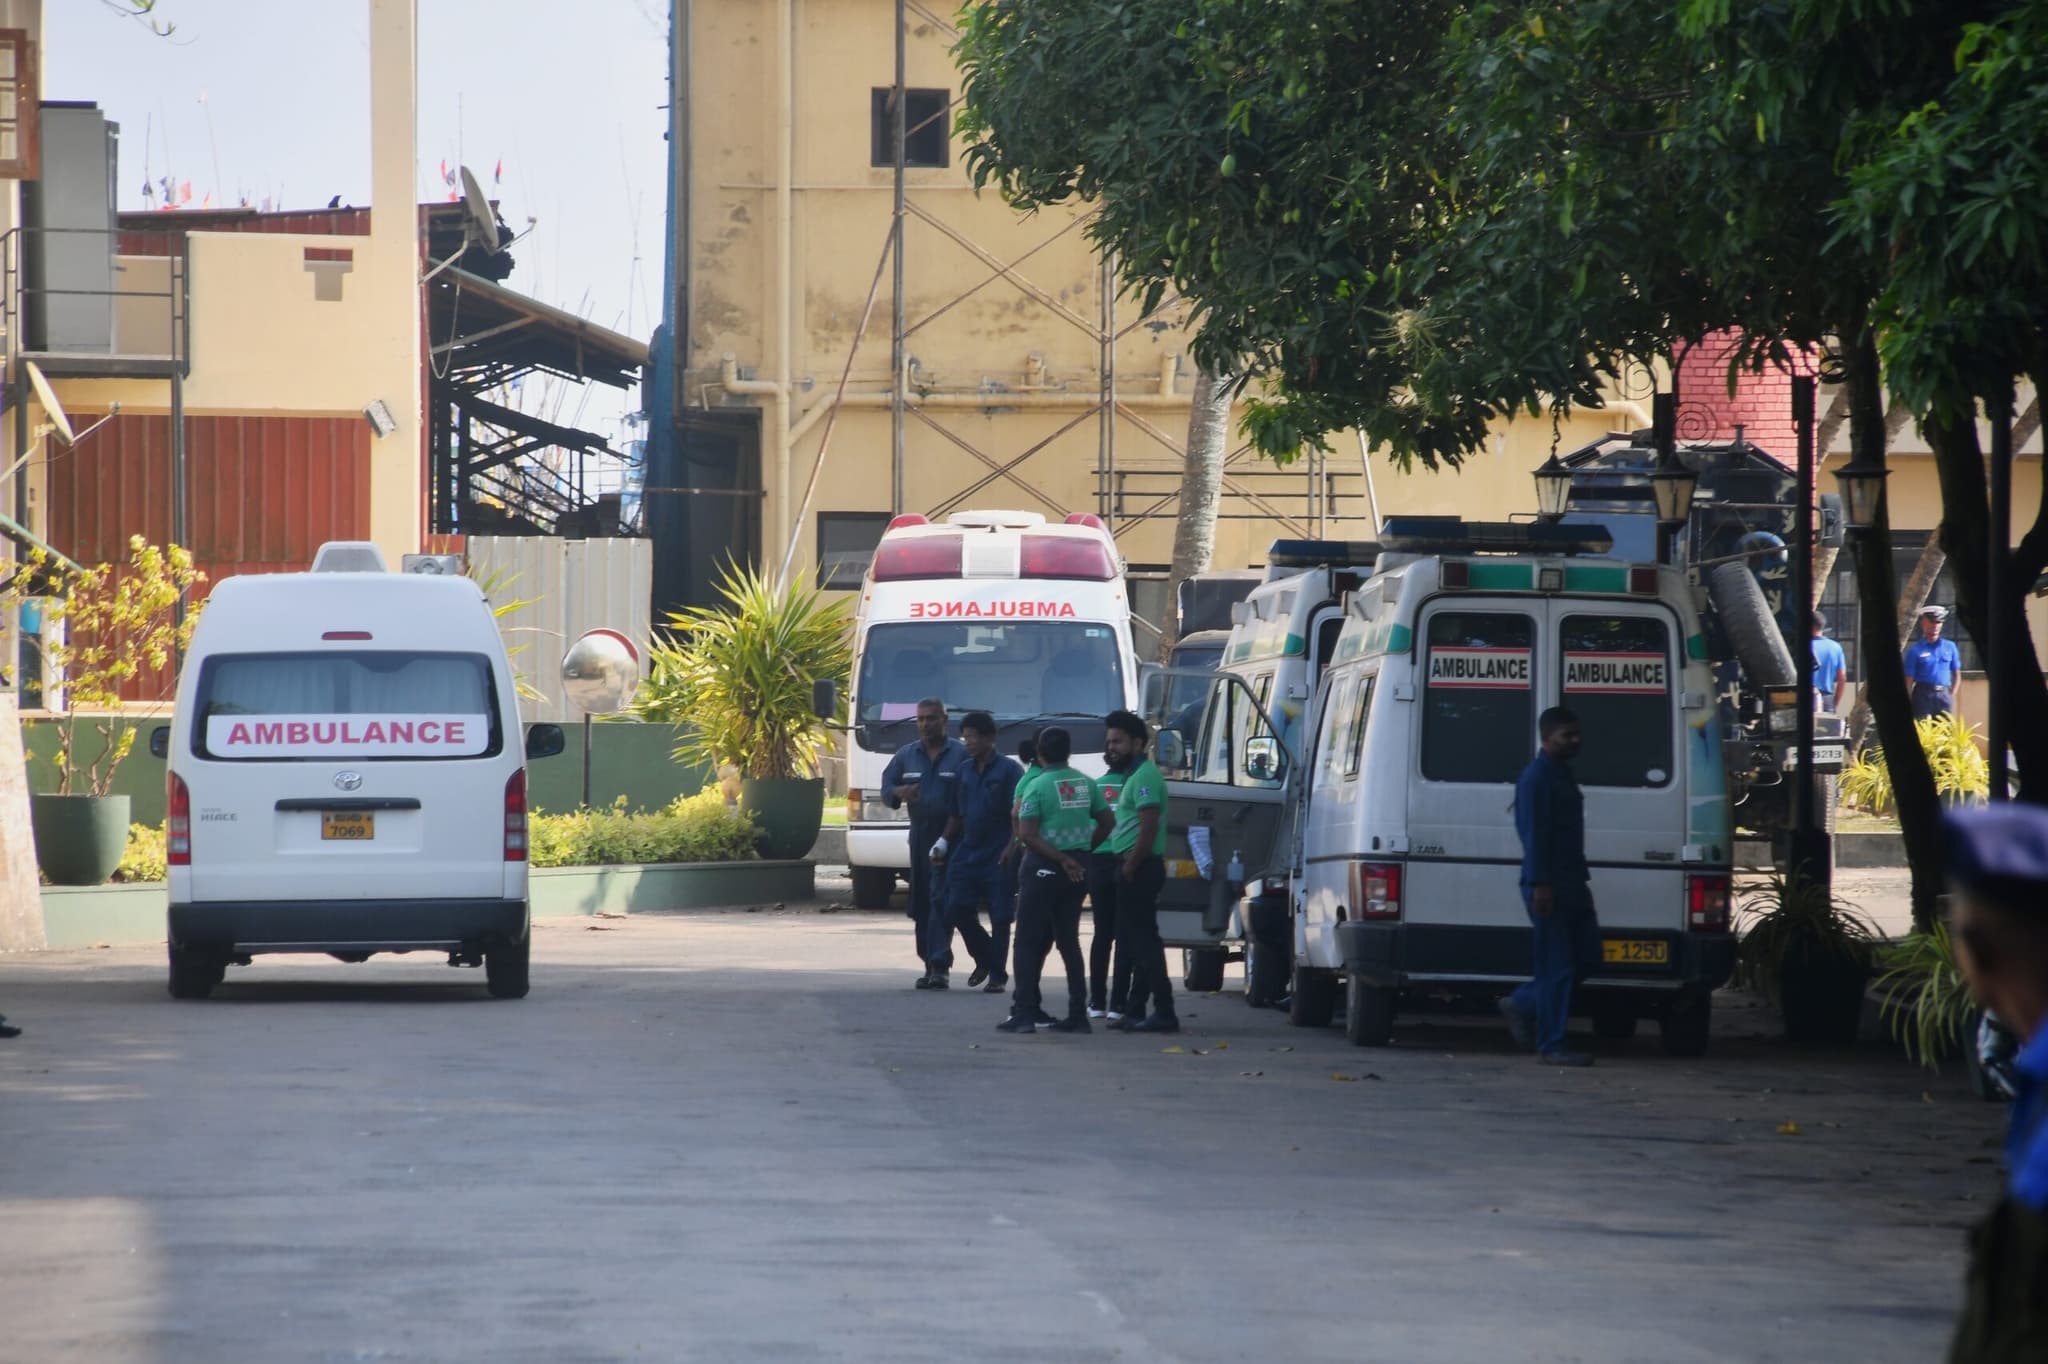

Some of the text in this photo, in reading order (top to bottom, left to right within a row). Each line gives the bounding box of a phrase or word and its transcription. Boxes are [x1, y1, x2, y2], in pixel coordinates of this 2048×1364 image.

[1431, 657, 1529, 680] AMBULANCE
[1566, 663, 1664, 684] AMBULANCE
[226, 721, 466, 745] AMBULANCE
[328, 825, 366, 838] 7069
